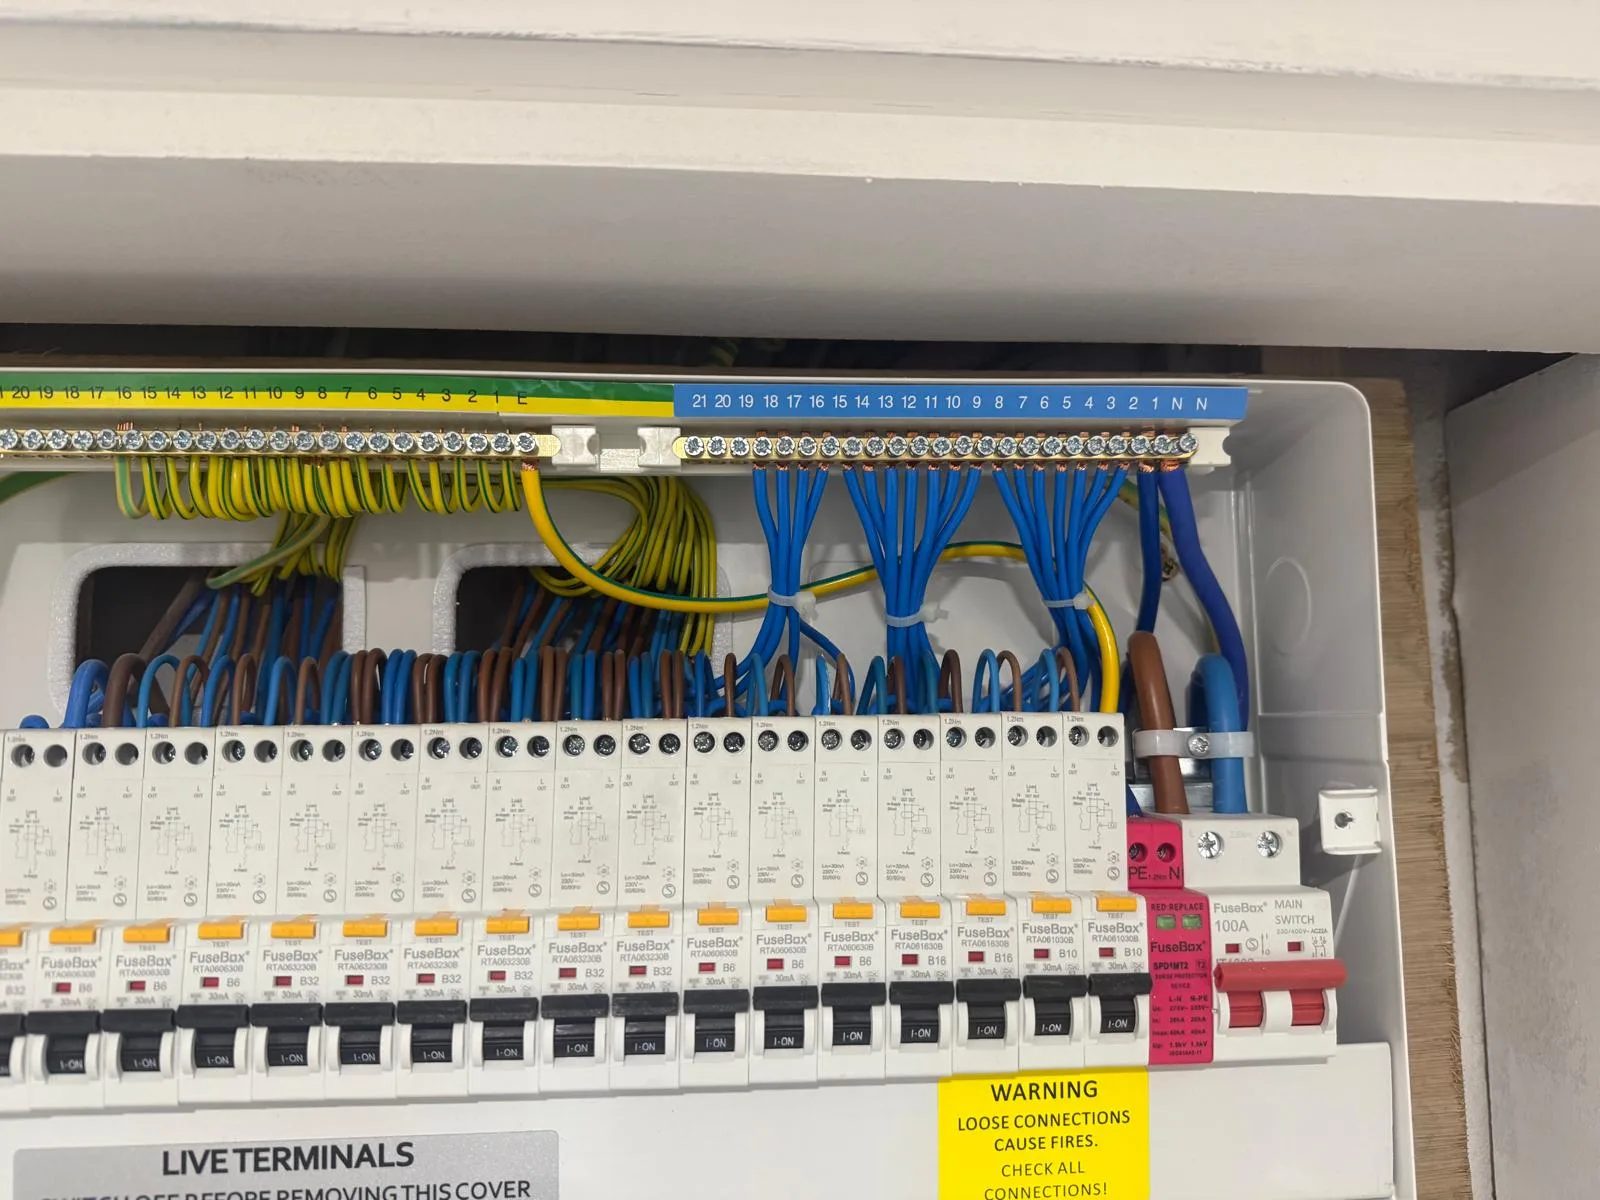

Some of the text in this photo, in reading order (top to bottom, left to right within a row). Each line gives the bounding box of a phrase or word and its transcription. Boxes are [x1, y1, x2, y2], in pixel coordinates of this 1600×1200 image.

[11, 386, 30, 399] 20
[38, 386, 54, 399] 19
[64, 386, 80, 399] 18
[88, 386, 104, 399] 17
[115, 386, 132, 399] 16
[140, 386, 157, 399] 15
[165, 386, 182, 399] 14
[191, 386, 207, 399] 13
[217, 386, 234, 399] 12
[243, 386, 257, 399] 11
[268, 386, 283, 399] 10
[295, 386, 305, 399] 9
[318, 386, 328, 399] 8
[342, 386, 351, 399] 7
[368, 386, 377, 399] 6
[392, 387, 403, 400] 5
[416, 388, 427, 401] 4
[441, 389, 452, 402] 3
[468, 390, 478, 403] 2
[494, 391, 499, 404] 1
[517, 392, 528, 405] E
[692, 394, 1208, 410] 21 20 19 18 17 16 15 14 13 12 11 10 9 8 7 6 5 4 3 2 1 N N
[1128, 866, 1148, 880] PE
[1169, 867, 1180, 880] N
[1275, 900, 1302, 909] MAIN
[1275, 915, 1314, 925] SWITCH
[1215, 920, 1248, 932] 100A
[1059, 949, 1078, 958] B10
[1125, 948, 1142, 957] B10
[860, 957, 872, 966] B6
[928, 956, 946, 965] B16
[995, 953, 1013, 962] B16
[723, 963, 736, 972] B6
[792, 960, 804, 968] B6
[1043, 963, 1062, 971] 30mA
[1109, 961, 1128, 970] 30mA
[515, 972, 533, 980] B32
[586, 969, 604, 977] B32
[654, 967, 672, 976] B32
[843, 971, 862, 979] 30mA
[911, 970, 930, 978] 30mA
[978, 967, 997, 976] 30mA
[227, 978, 240, 987] B6
[300, 976, 319, 986] B32
[372, 976, 390, 985] B32
[442, 975, 461, 984] B32
[706, 977, 725, 985] 30mA
[775, 974, 795, 982] 30mA
[79, 981, 92, 992] B6
[153, 981, 167, 991] B6
[496, 985, 517, 993] 30mA
[568, 983, 588, 991] 30mA
[636, 981, 656, 990] 30mA
[209, 992, 229, 1000] 30mA
[282, 990, 302, 999] 30mA
[353, 990, 373, 998] 30mA
[424, 989, 445, 997] 30mA
[991, 1080, 1098, 1101] WARNING
[958, 1110, 1130, 1131] LOOSE CONNECTIONS
[994, 1135, 1098, 1151] CAUSE FIRES.
[162, 1142, 414, 1176] LIVE TERMINALS
[1002, 1162, 1084, 1177] CHECK ALL
[401, 1184, 452, 1200] THIS
[456, 1180, 531, 1199] COVER
[985, 1183, 1107, 1200] CONNECTIONS!
